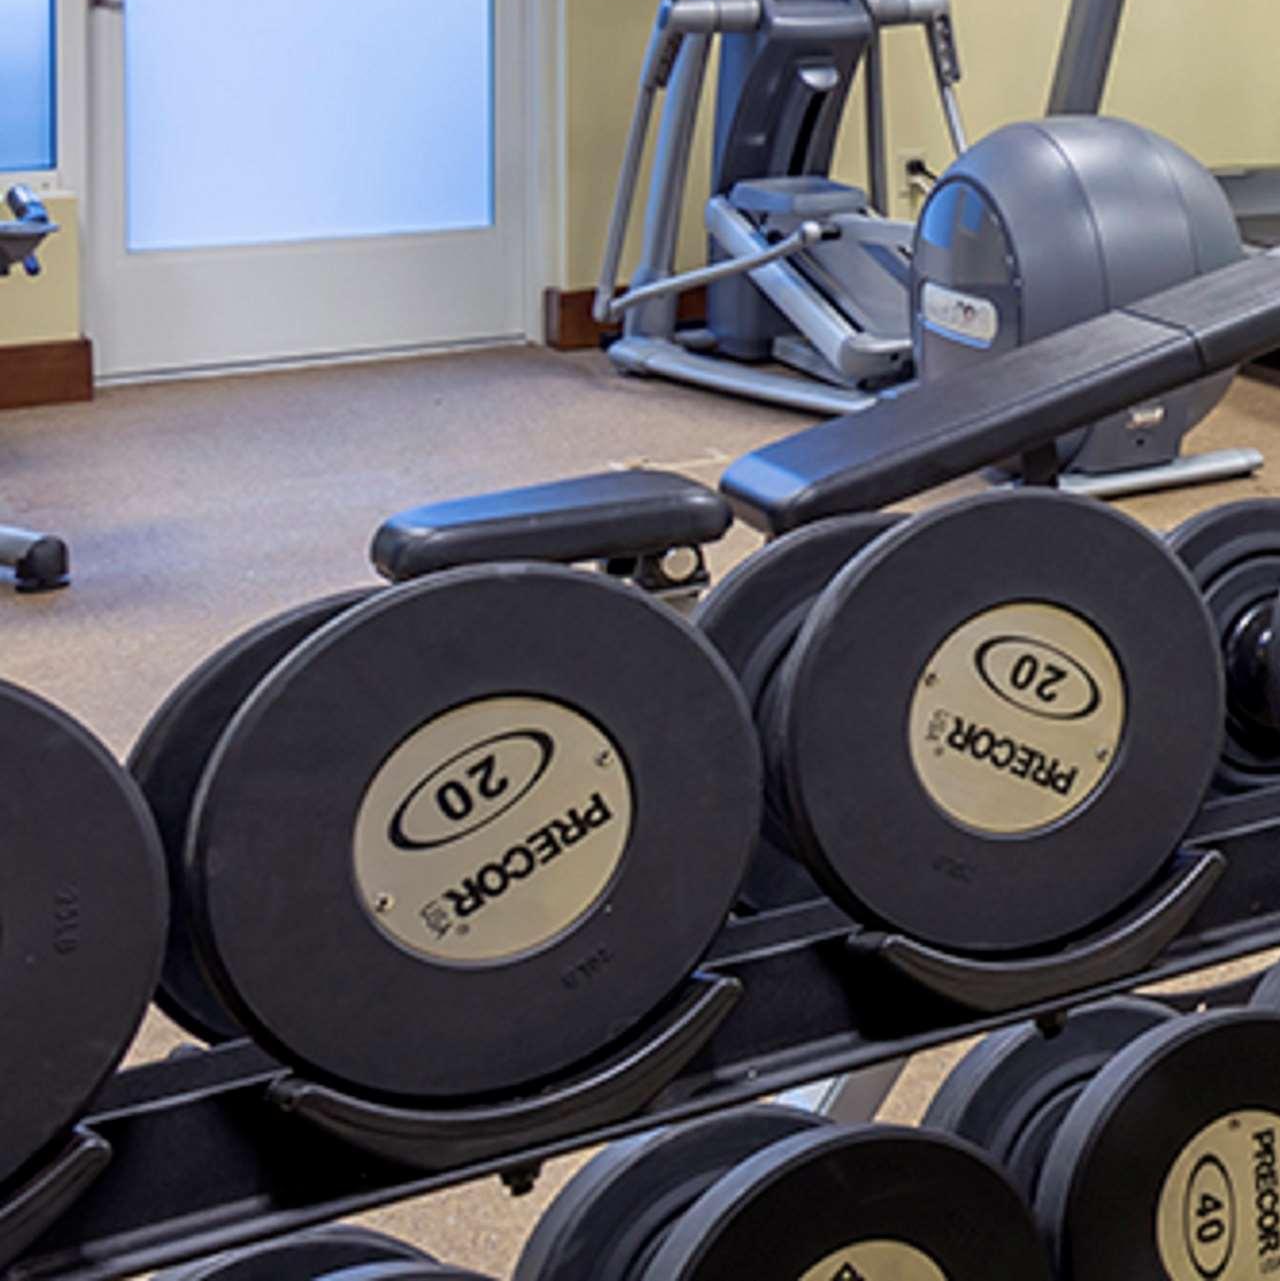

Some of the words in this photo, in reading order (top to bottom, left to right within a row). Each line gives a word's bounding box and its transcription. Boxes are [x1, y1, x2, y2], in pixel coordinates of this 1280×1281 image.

[1008, 653, 1069, 704] 20
[434, 752, 510, 822] 20
[945, 715, 1081, 798] PRECOR
[440, 791, 615, 919] PRECOR
[1195, 1192, 1226, 1245] 40
